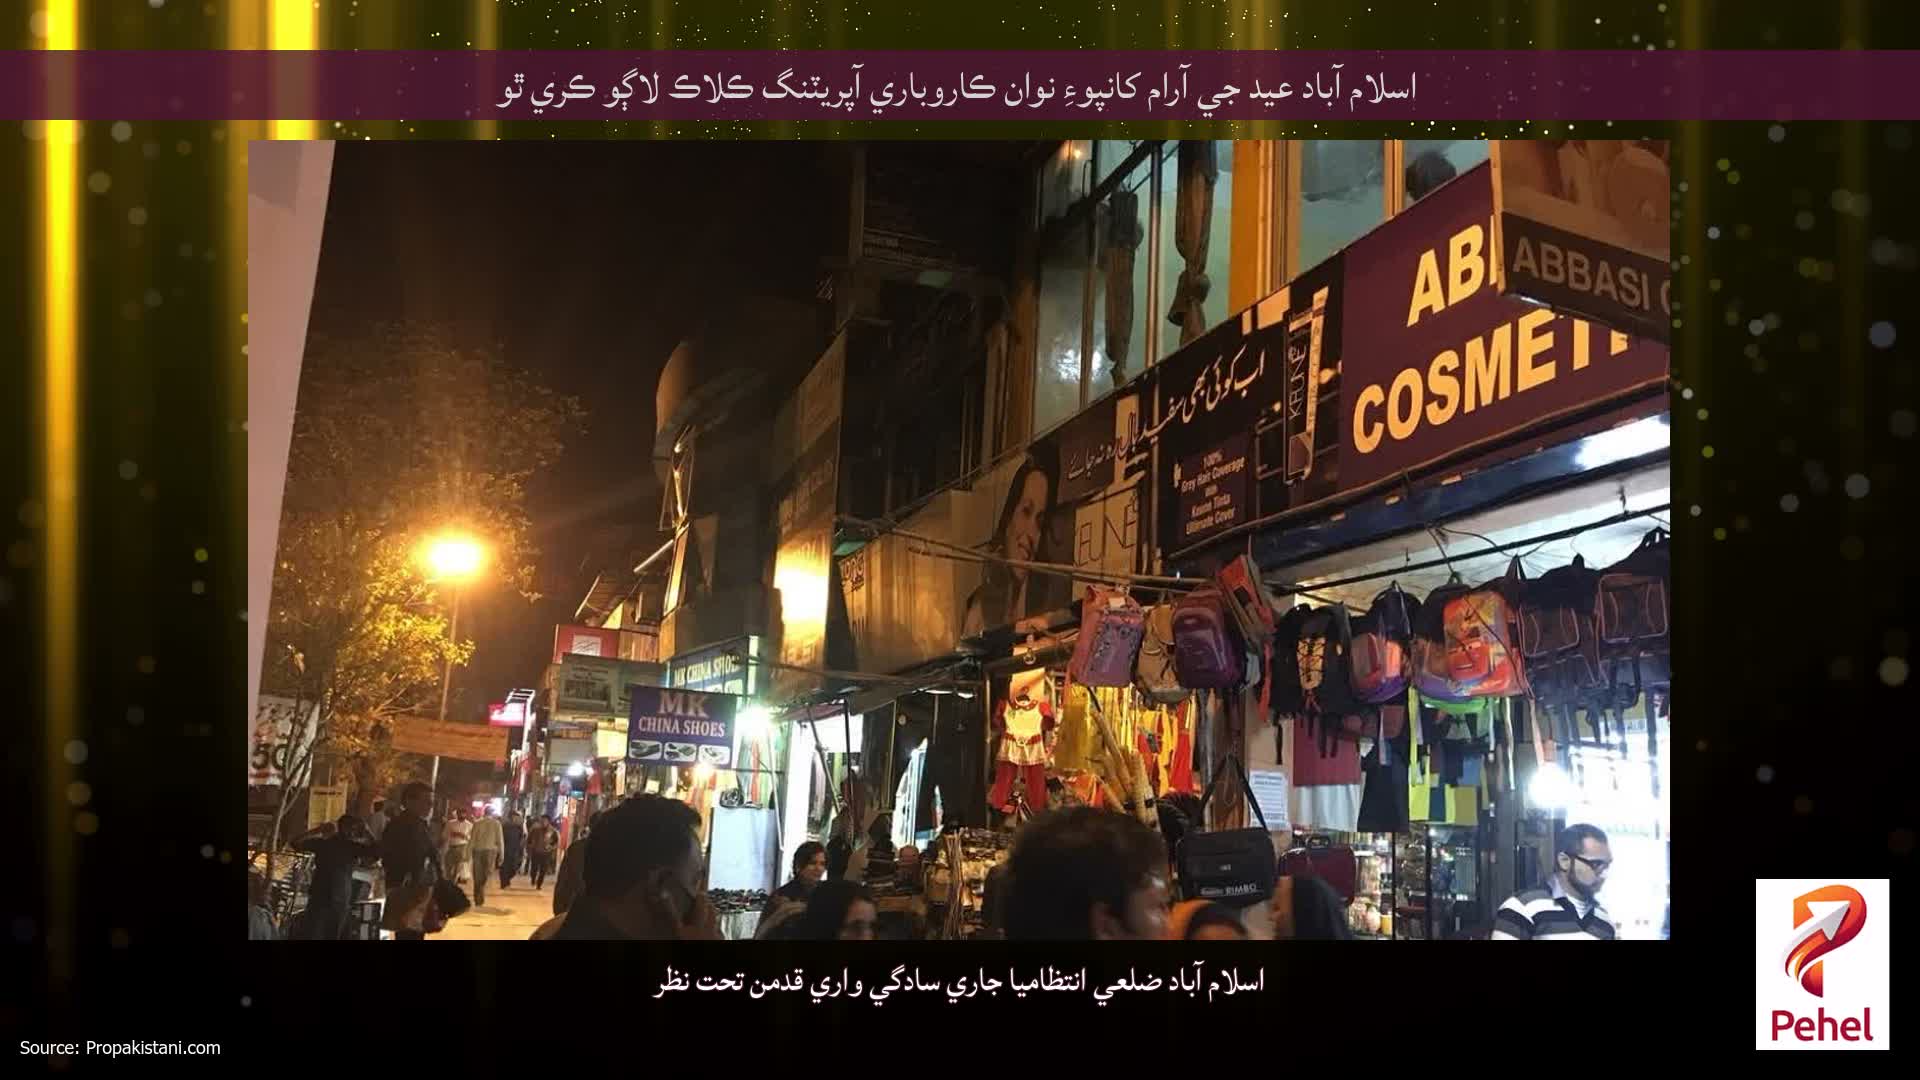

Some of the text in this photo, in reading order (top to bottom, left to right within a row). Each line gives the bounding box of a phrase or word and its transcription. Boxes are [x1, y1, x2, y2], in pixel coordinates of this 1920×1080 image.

[1512, 236, 1650, 309] ABBASI
[657, 690, 711, 719] MK
[638, 716, 726, 738] CHINA SHOES
